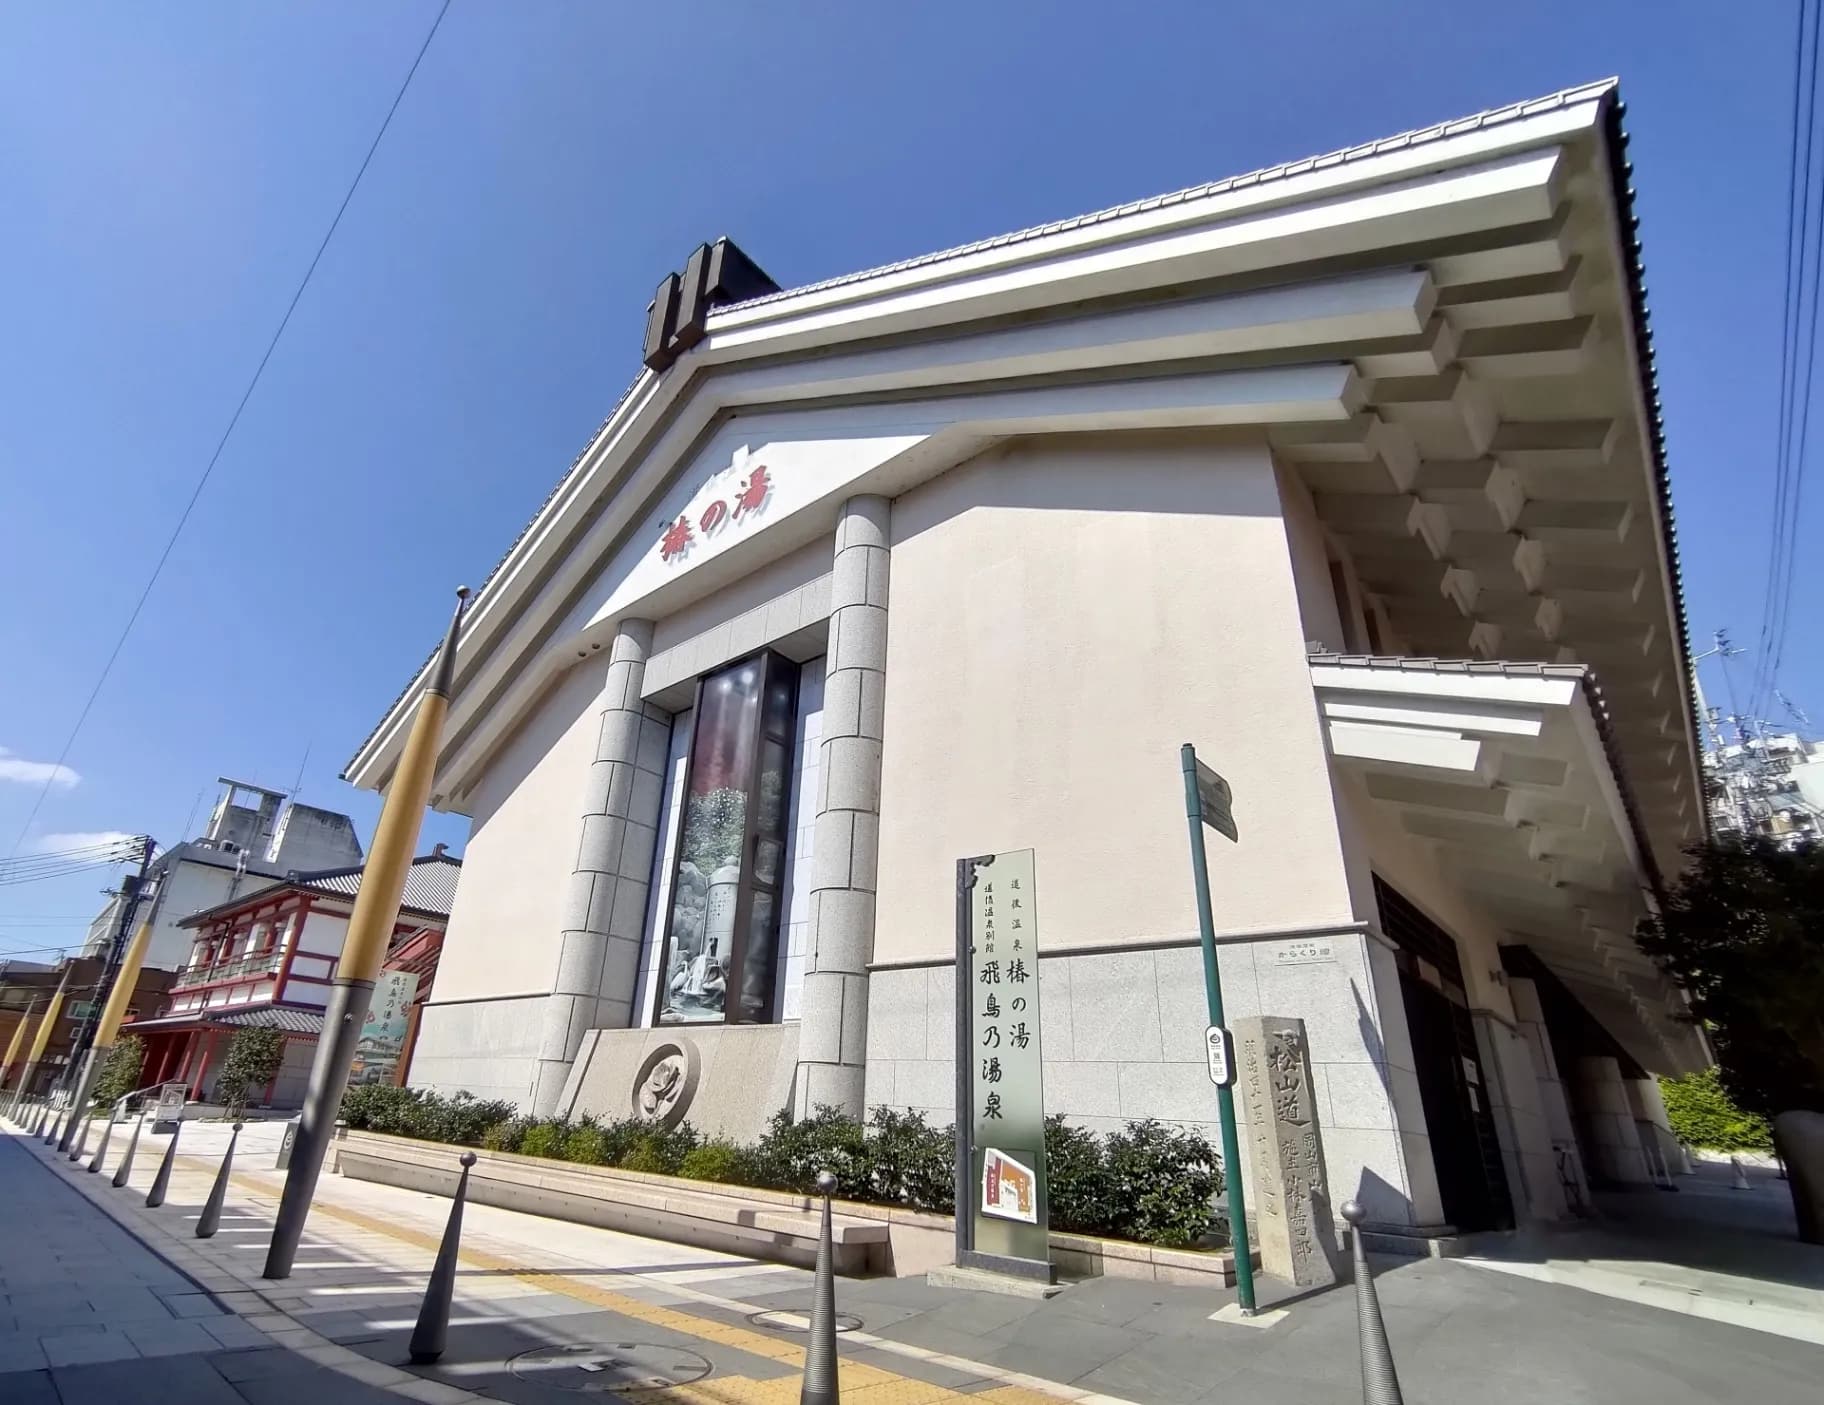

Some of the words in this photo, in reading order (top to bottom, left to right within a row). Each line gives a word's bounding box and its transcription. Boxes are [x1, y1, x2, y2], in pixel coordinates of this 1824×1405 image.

[1010, 879, 1023, 952] 道後温泉
[979, 960, 1003, 1120] 飛鳥乃湯泉
[1006, 958, 1031, 1050] 椿の湯
